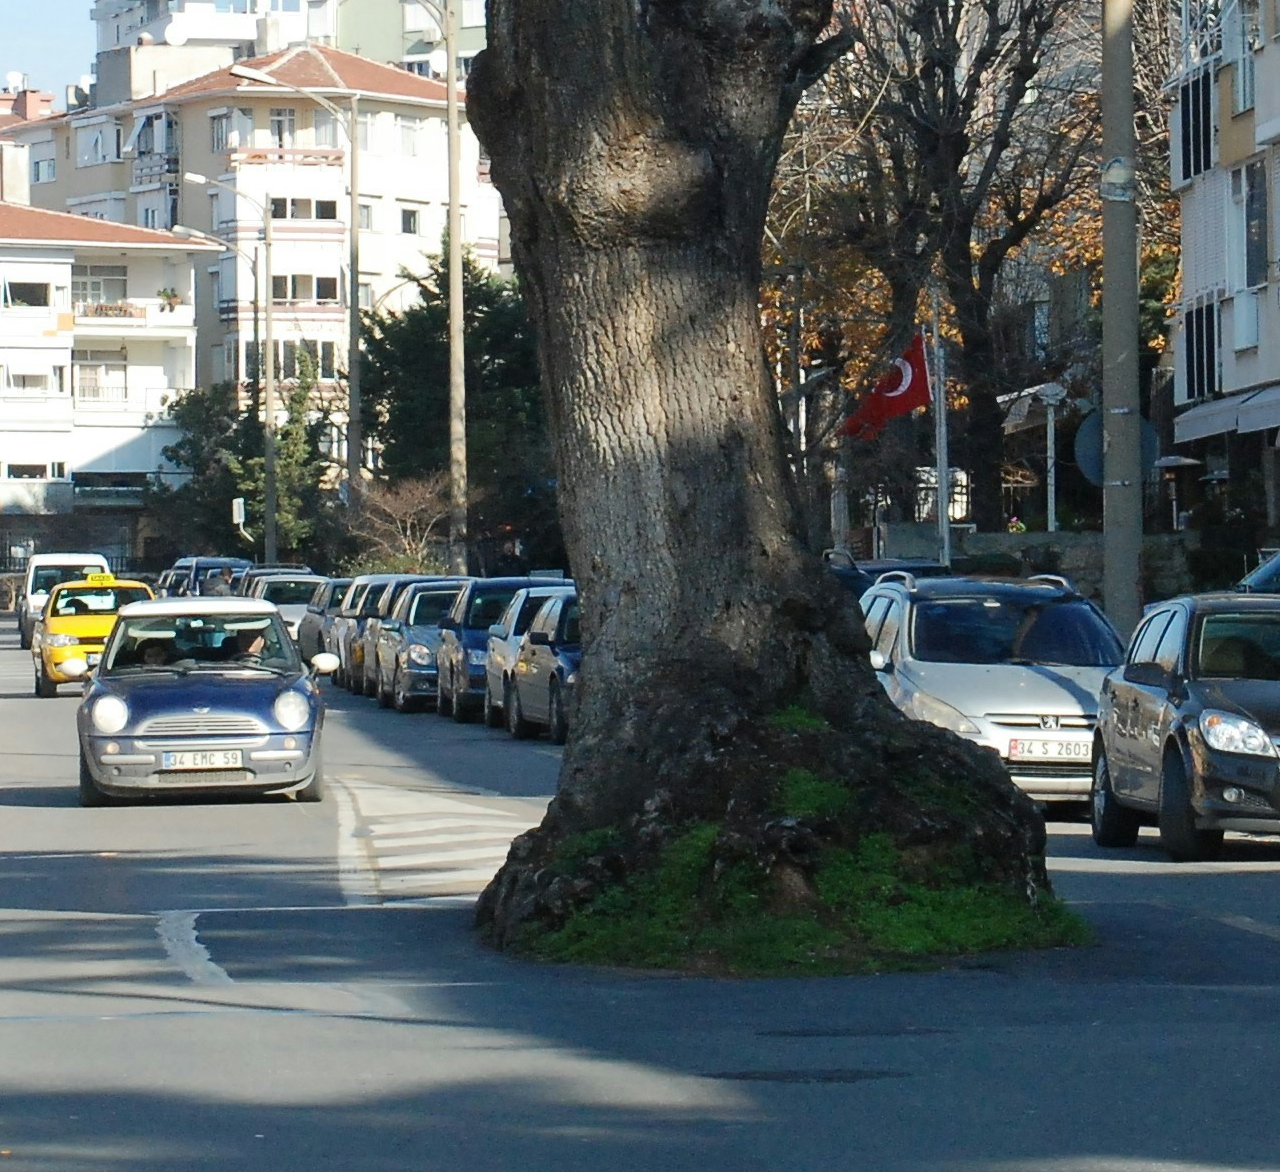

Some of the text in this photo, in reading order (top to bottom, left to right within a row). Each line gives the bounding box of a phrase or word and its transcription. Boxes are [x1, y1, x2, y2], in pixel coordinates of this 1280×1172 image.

[1019, 741, 1089, 757] 34 S 2603
[171, 752, 238, 766] 34 EMC 59
